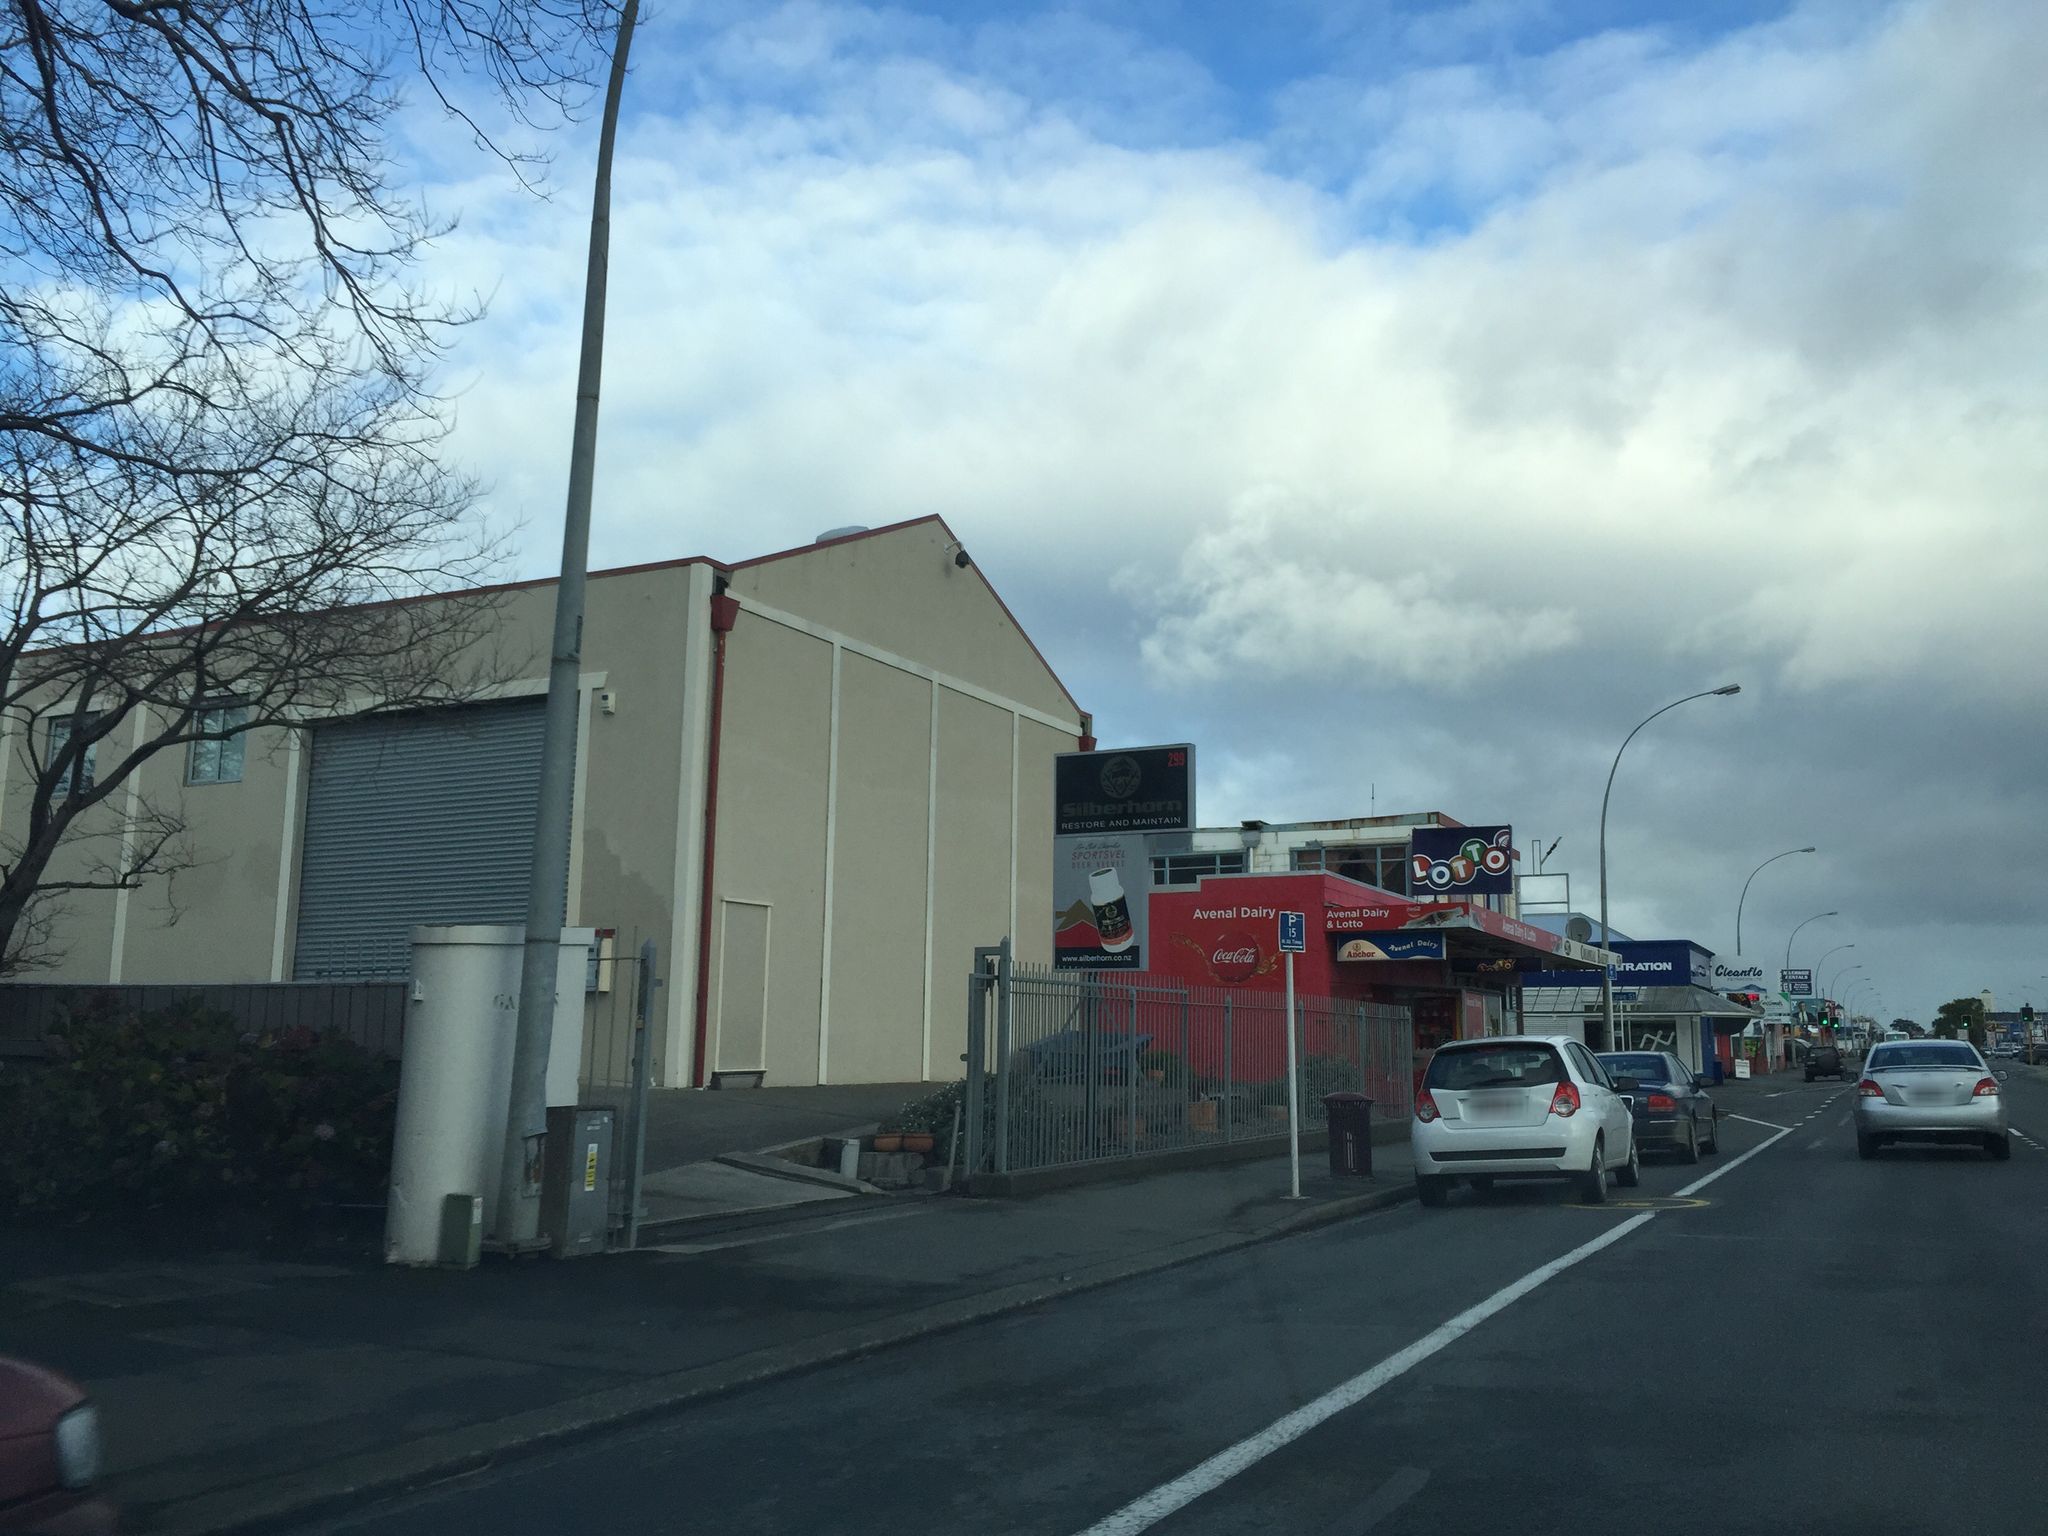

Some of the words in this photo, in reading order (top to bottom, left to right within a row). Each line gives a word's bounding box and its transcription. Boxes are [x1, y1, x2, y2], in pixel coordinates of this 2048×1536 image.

[1062, 801, 1183, 818] Silberhorn
[1061, 821, 1106, 831] RESTORE
[1109, 819, 1130, 828] AND
[1133, 816, 1182, 826] MAINTAIN
[1413, 843, 1505, 884] LOTTO
[1193, 907, 1237, 920] Avenal
[1241, 906, 1276, 920] Dairy
[1327, 909, 1360, 919] Avenal
[1363, 908, 1390, 919] Dairy
[1288, 915, 1297, 927] P
[1337, 919, 1364, 928] Lotto
[1288, 928, 1297, 938] 15
[1388, 941, 1414, 952] Avenal
[1417, 940, 1439, 950] Dairy
[1347, 950, 1376, 959] Anchor
[1714, 964, 1763, 977] Cleanflo
